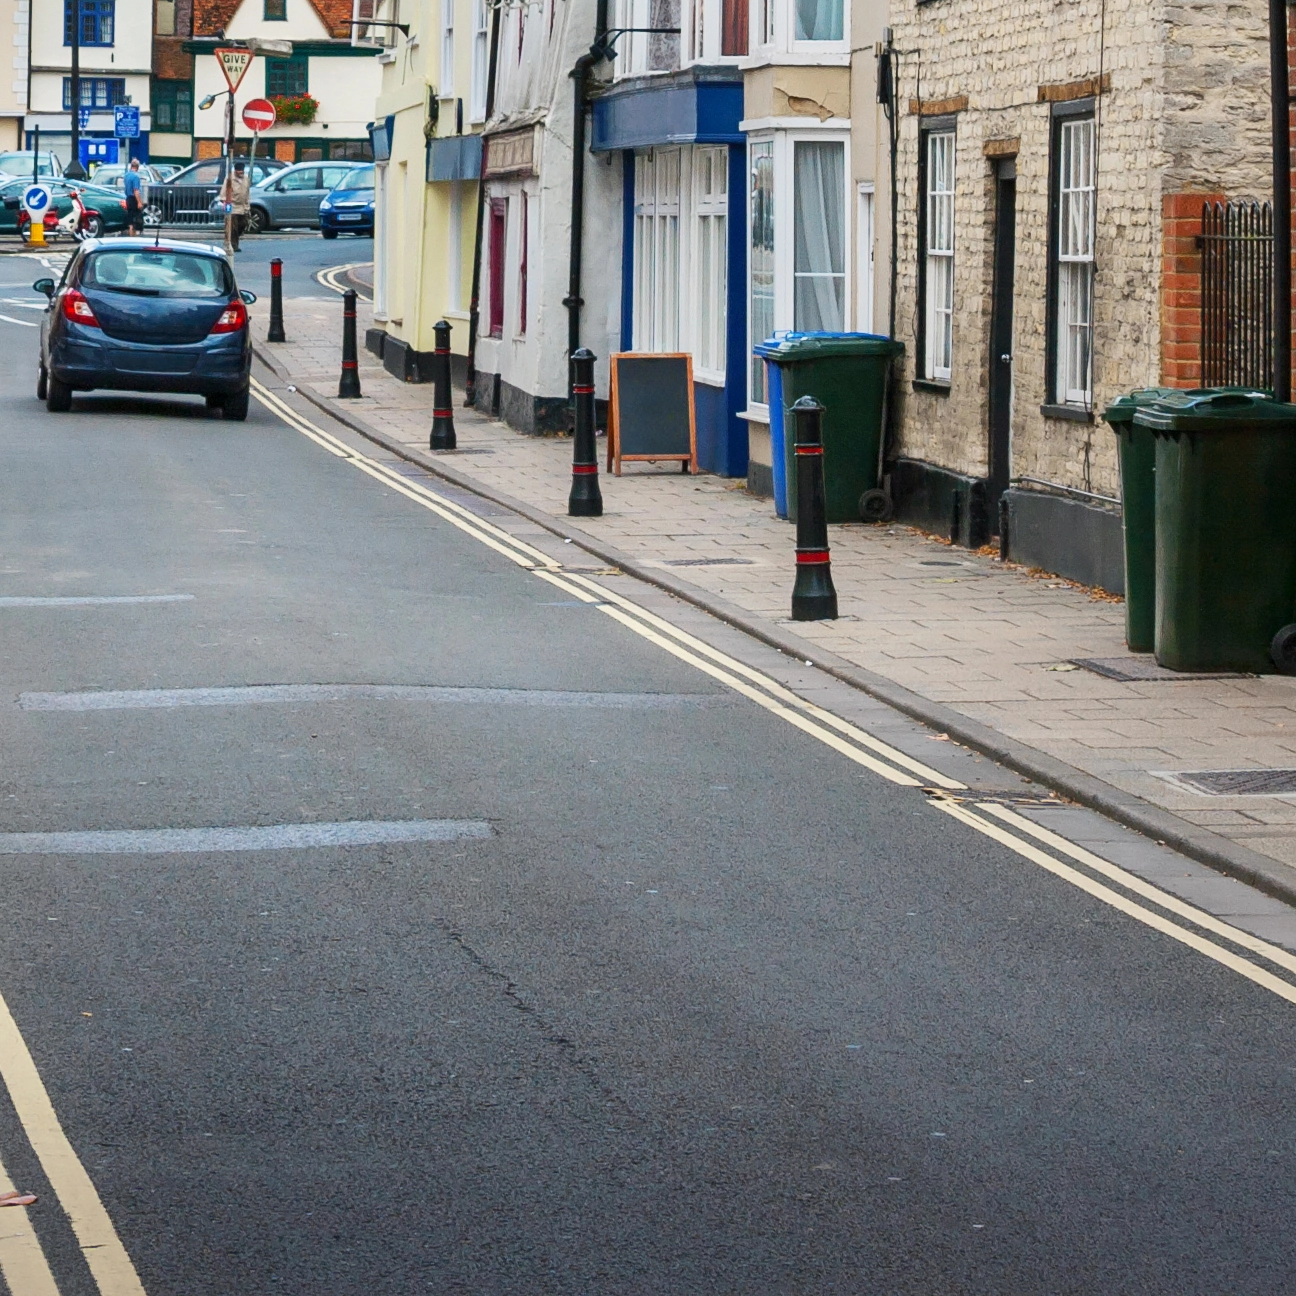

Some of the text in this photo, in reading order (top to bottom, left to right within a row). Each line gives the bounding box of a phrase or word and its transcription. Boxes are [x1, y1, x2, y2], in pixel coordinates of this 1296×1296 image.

[223, 54, 246, 64] GIVE
[227, 65, 243, 73] WAY
[116, 112, 124, 121] P
